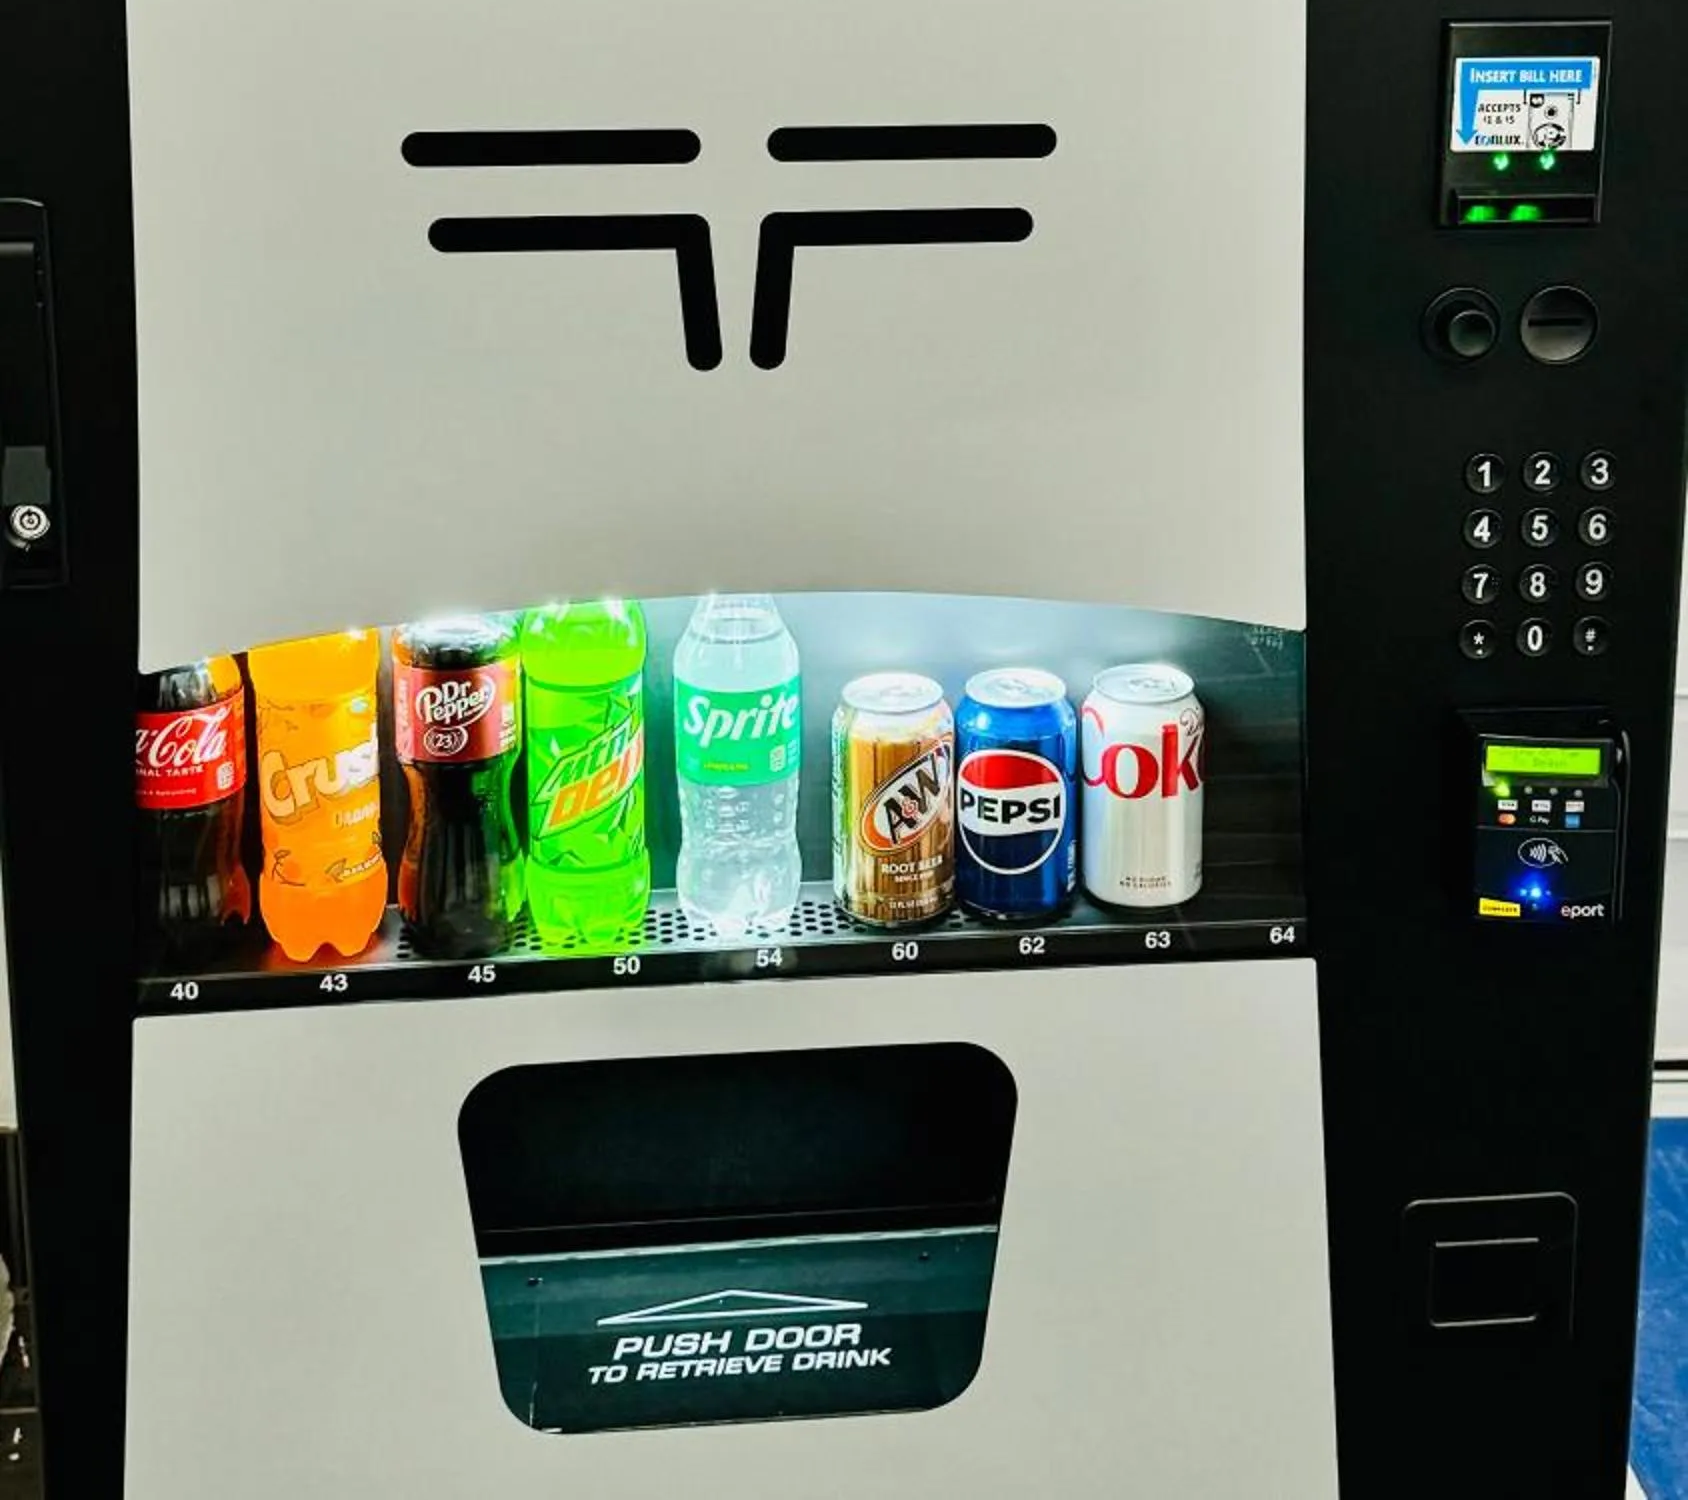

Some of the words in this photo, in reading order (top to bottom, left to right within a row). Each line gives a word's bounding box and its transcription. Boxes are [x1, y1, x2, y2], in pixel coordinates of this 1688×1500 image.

[1470, 68, 1516, 84] INSERT
[1519, 68, 1546, 83] BILL
[1549, 69, 1584, 83] HERE
[1477, 103, 1521, 113] ACCEPTS
[1477, 461, 1492, 488] 1
[1534, 459, 1551, 486] 2
[1590, 457, 1609, 485] 3
[1473, 515, 1491, 543] 4
[1531, 514, 1549, 541] 5
[1588, 513, 1607, 540] 6
[1473, 573, 1489, 599] 7
[1529, 571, 1546, 598] 8
[1585, 569, 1603, 596] 9
[1526, 625, 1543, 652] 0
[442, 681, 472, 701] Dr
[416, 685, 492, 725] Pepper
[683, 693, 799, 748] Sprite
[435, 733, 453, 749] 23
[164, 765, 204, 778] TASTE
[261, 721, 379, 818] Crus
[960, 788, 1061, 824] PEPSI
[881, 862, 916, 874] ROOT
[1560, 903, 1605, 919] eport
[1145, 931, 1171, 949] 63
[1269, 927, 1296, 944] 64
[891, 942, 919, 961] 60
[1019, 937, 1045, 955] 62
[612, 956, 641, 975] 50
[755, 949, 782, 967] 54
[319, 975, 348, 992] 43
[467, 965, 496, 984] 45
[169, 981, 199, 1000] 40
[612, 1329, 732, 1361] PUSH
[744, 1322, 862, 1352] DOOR
[588, 1364, 628, 1385] TO
[636, 1353, 784, 1382] RETRIEVE
[791, 1347, 893, 1372] DRINK
